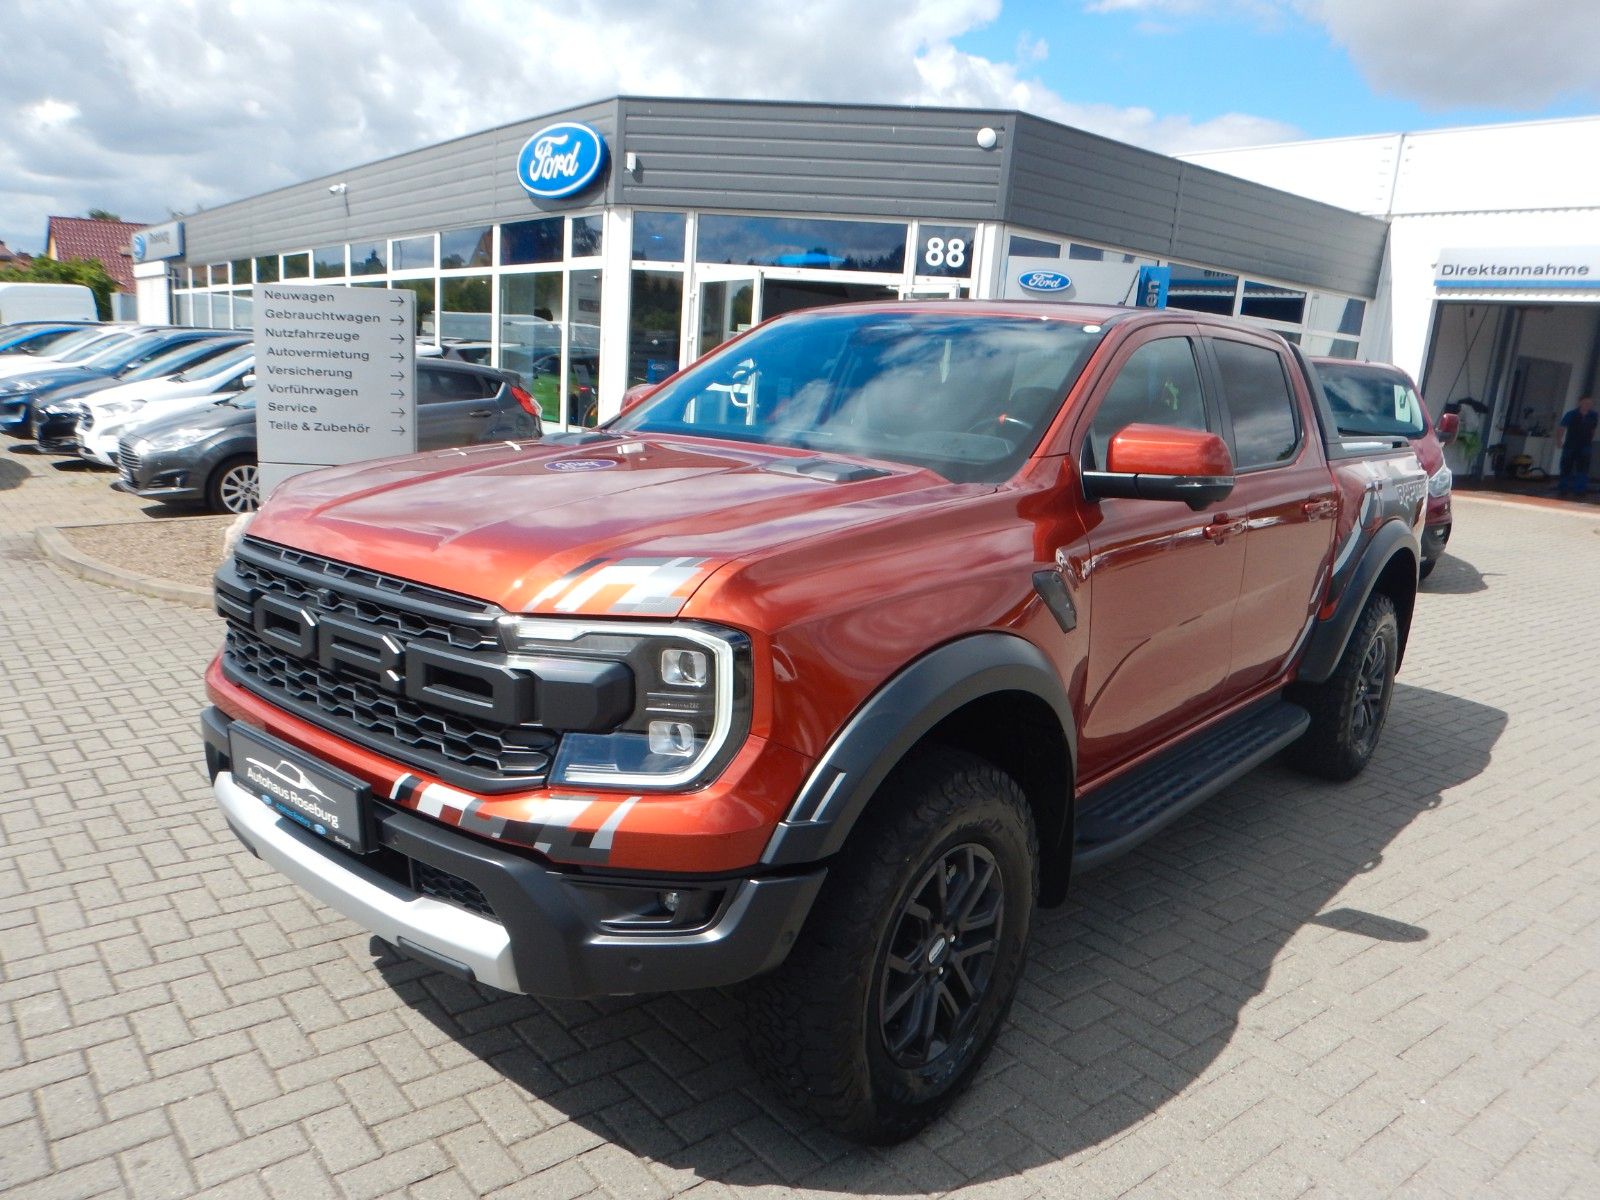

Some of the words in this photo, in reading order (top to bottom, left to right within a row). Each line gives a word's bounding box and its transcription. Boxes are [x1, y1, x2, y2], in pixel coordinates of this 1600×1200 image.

[529, 134, 581, 182] Ford
[925, 237, 965, 268] 88
[1441, 263, 1589, 276] Direktannahme
[1028, 273, 1062, 289] Ford
[264, 290, 335, 303] Neuwagen
[265, 309, 381, 324] Gebrauchtwagen
[265, 328, 360, 342] Nutzfahrzeuge
[267, 347, 370, 361] Autovermietung
[267, 365, 353, 379] Versicherung
[268, 384, 359, 397] Vorführwagen
[268, 402, 318, 413] Service
[269, 420, 298, 431] Teile
[301, 422, 310, 431] &
[314, 422, 370, 433] Zubehör
[247, 768, 290, 800] Autohaus
[290, 790, 339, 829] Roseburg
